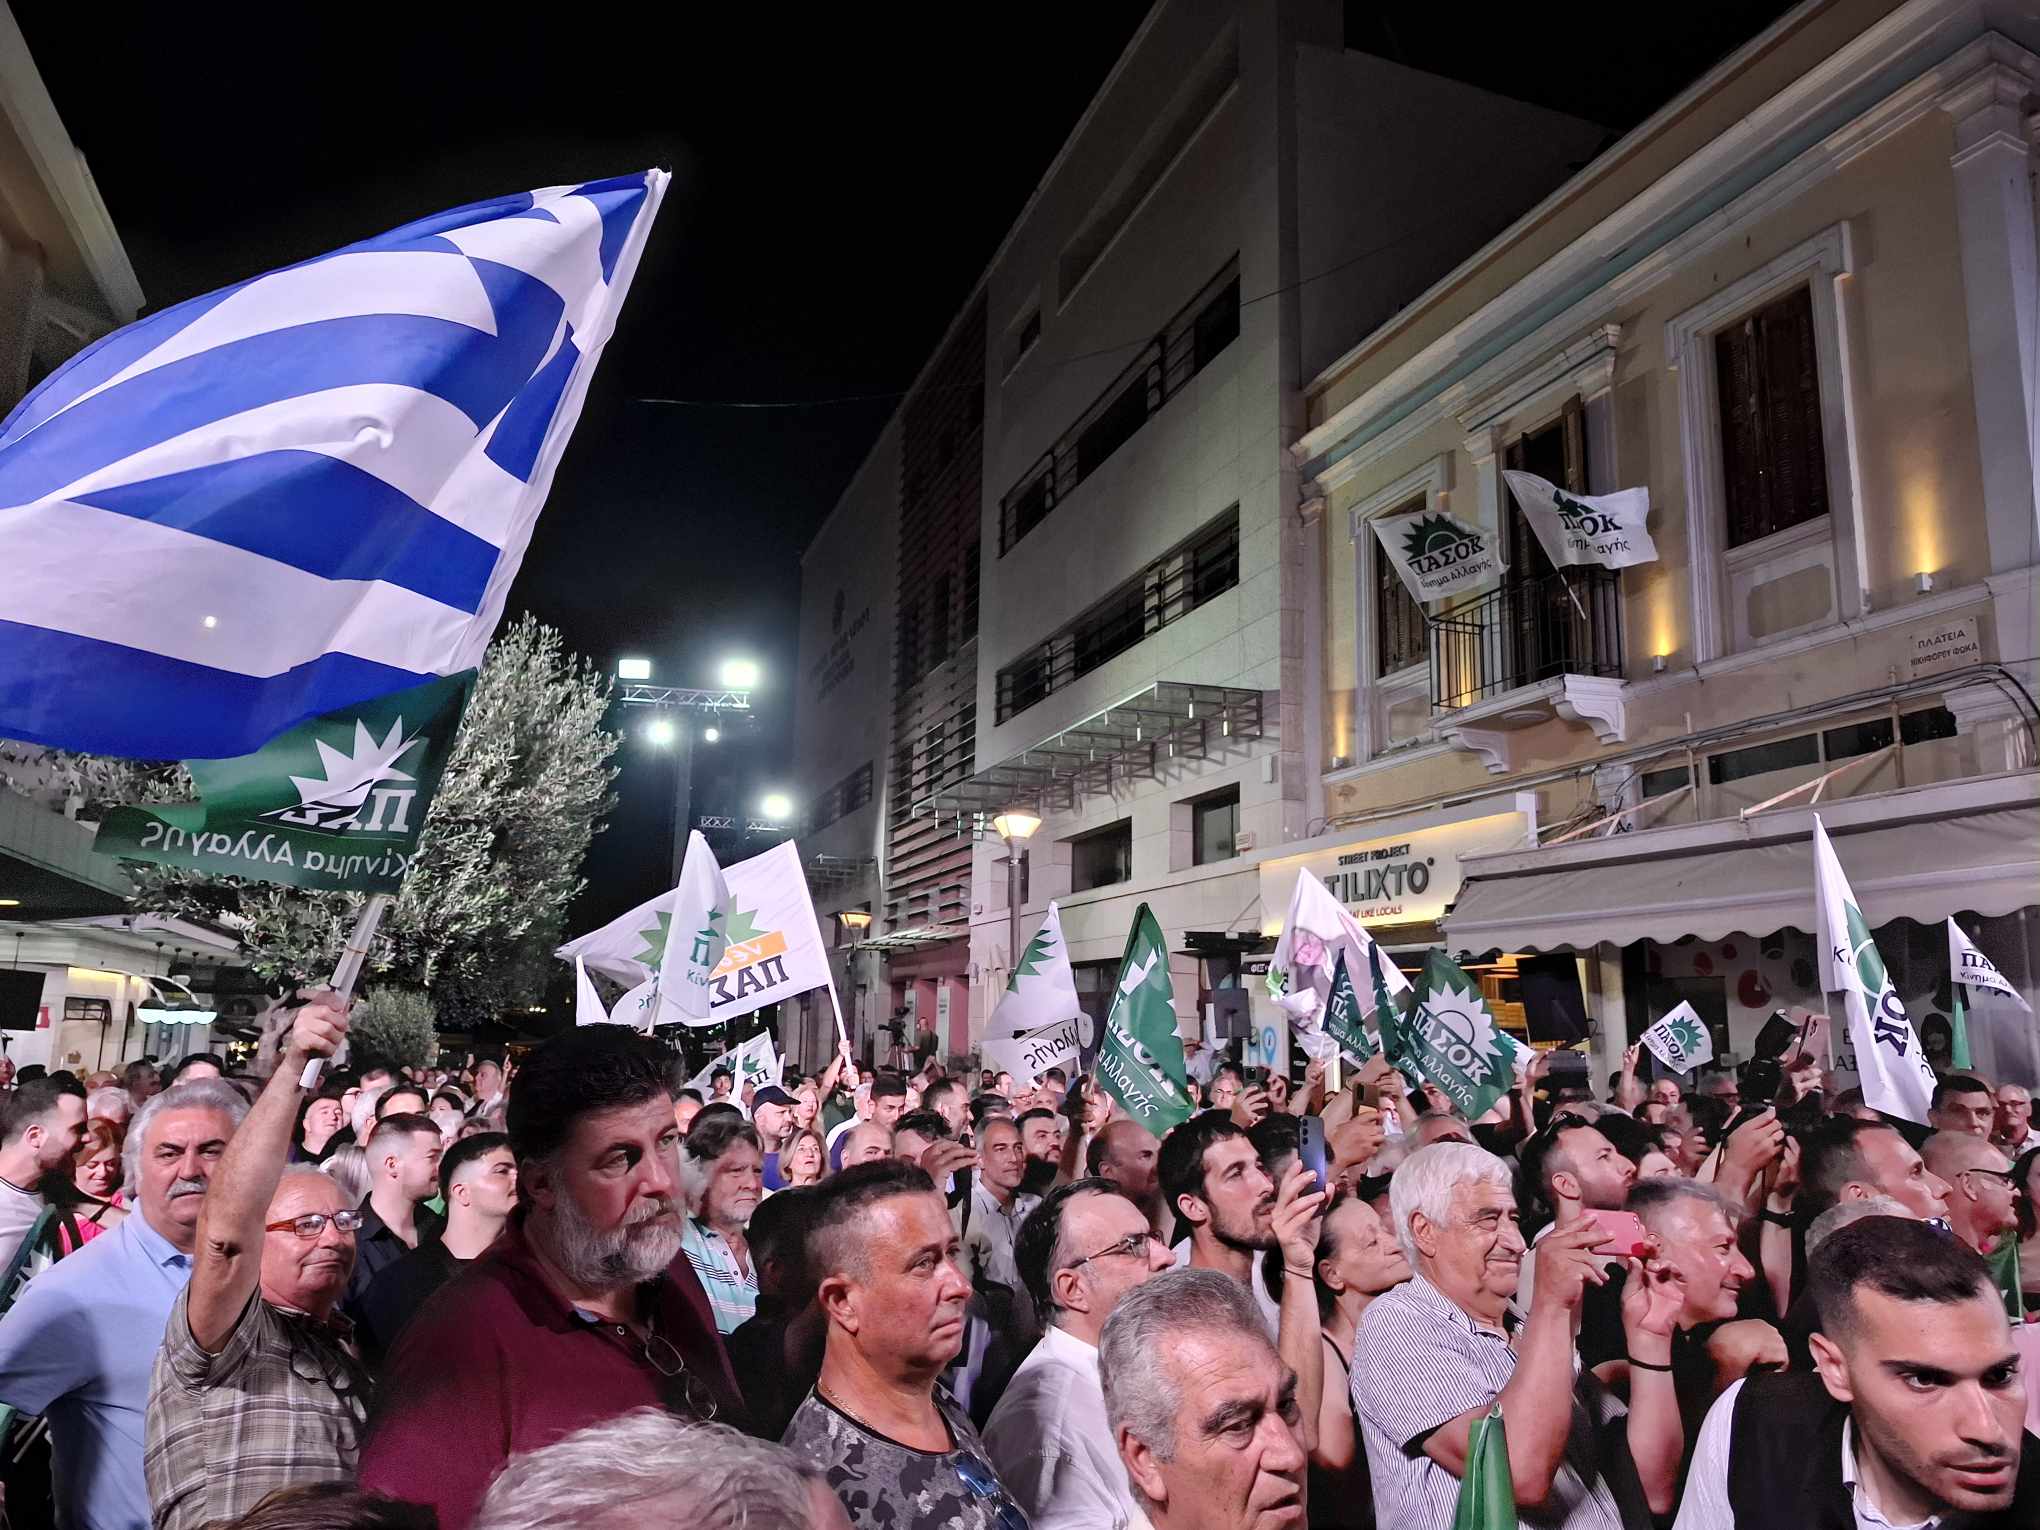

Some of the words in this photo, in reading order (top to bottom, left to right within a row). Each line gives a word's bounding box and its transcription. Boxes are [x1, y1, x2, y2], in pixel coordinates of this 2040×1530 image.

[1918, 629, 1966, 649] ΠΛΑΤΕΙΑ
[1338, 851, 1369, 866] STREET
[1370, 843, 1410, 860] PROJECT
[1323, 861, 1430, 904] TILIXTO
[1361, 907, 1376, 918] LIKE
[1375, 904, 1403, 917] LOCALS
[1412, 1005, 1493, 1087] ΠΑΣΟΚ
[1420, 1055, 1474, 1106] Αλλαγής
